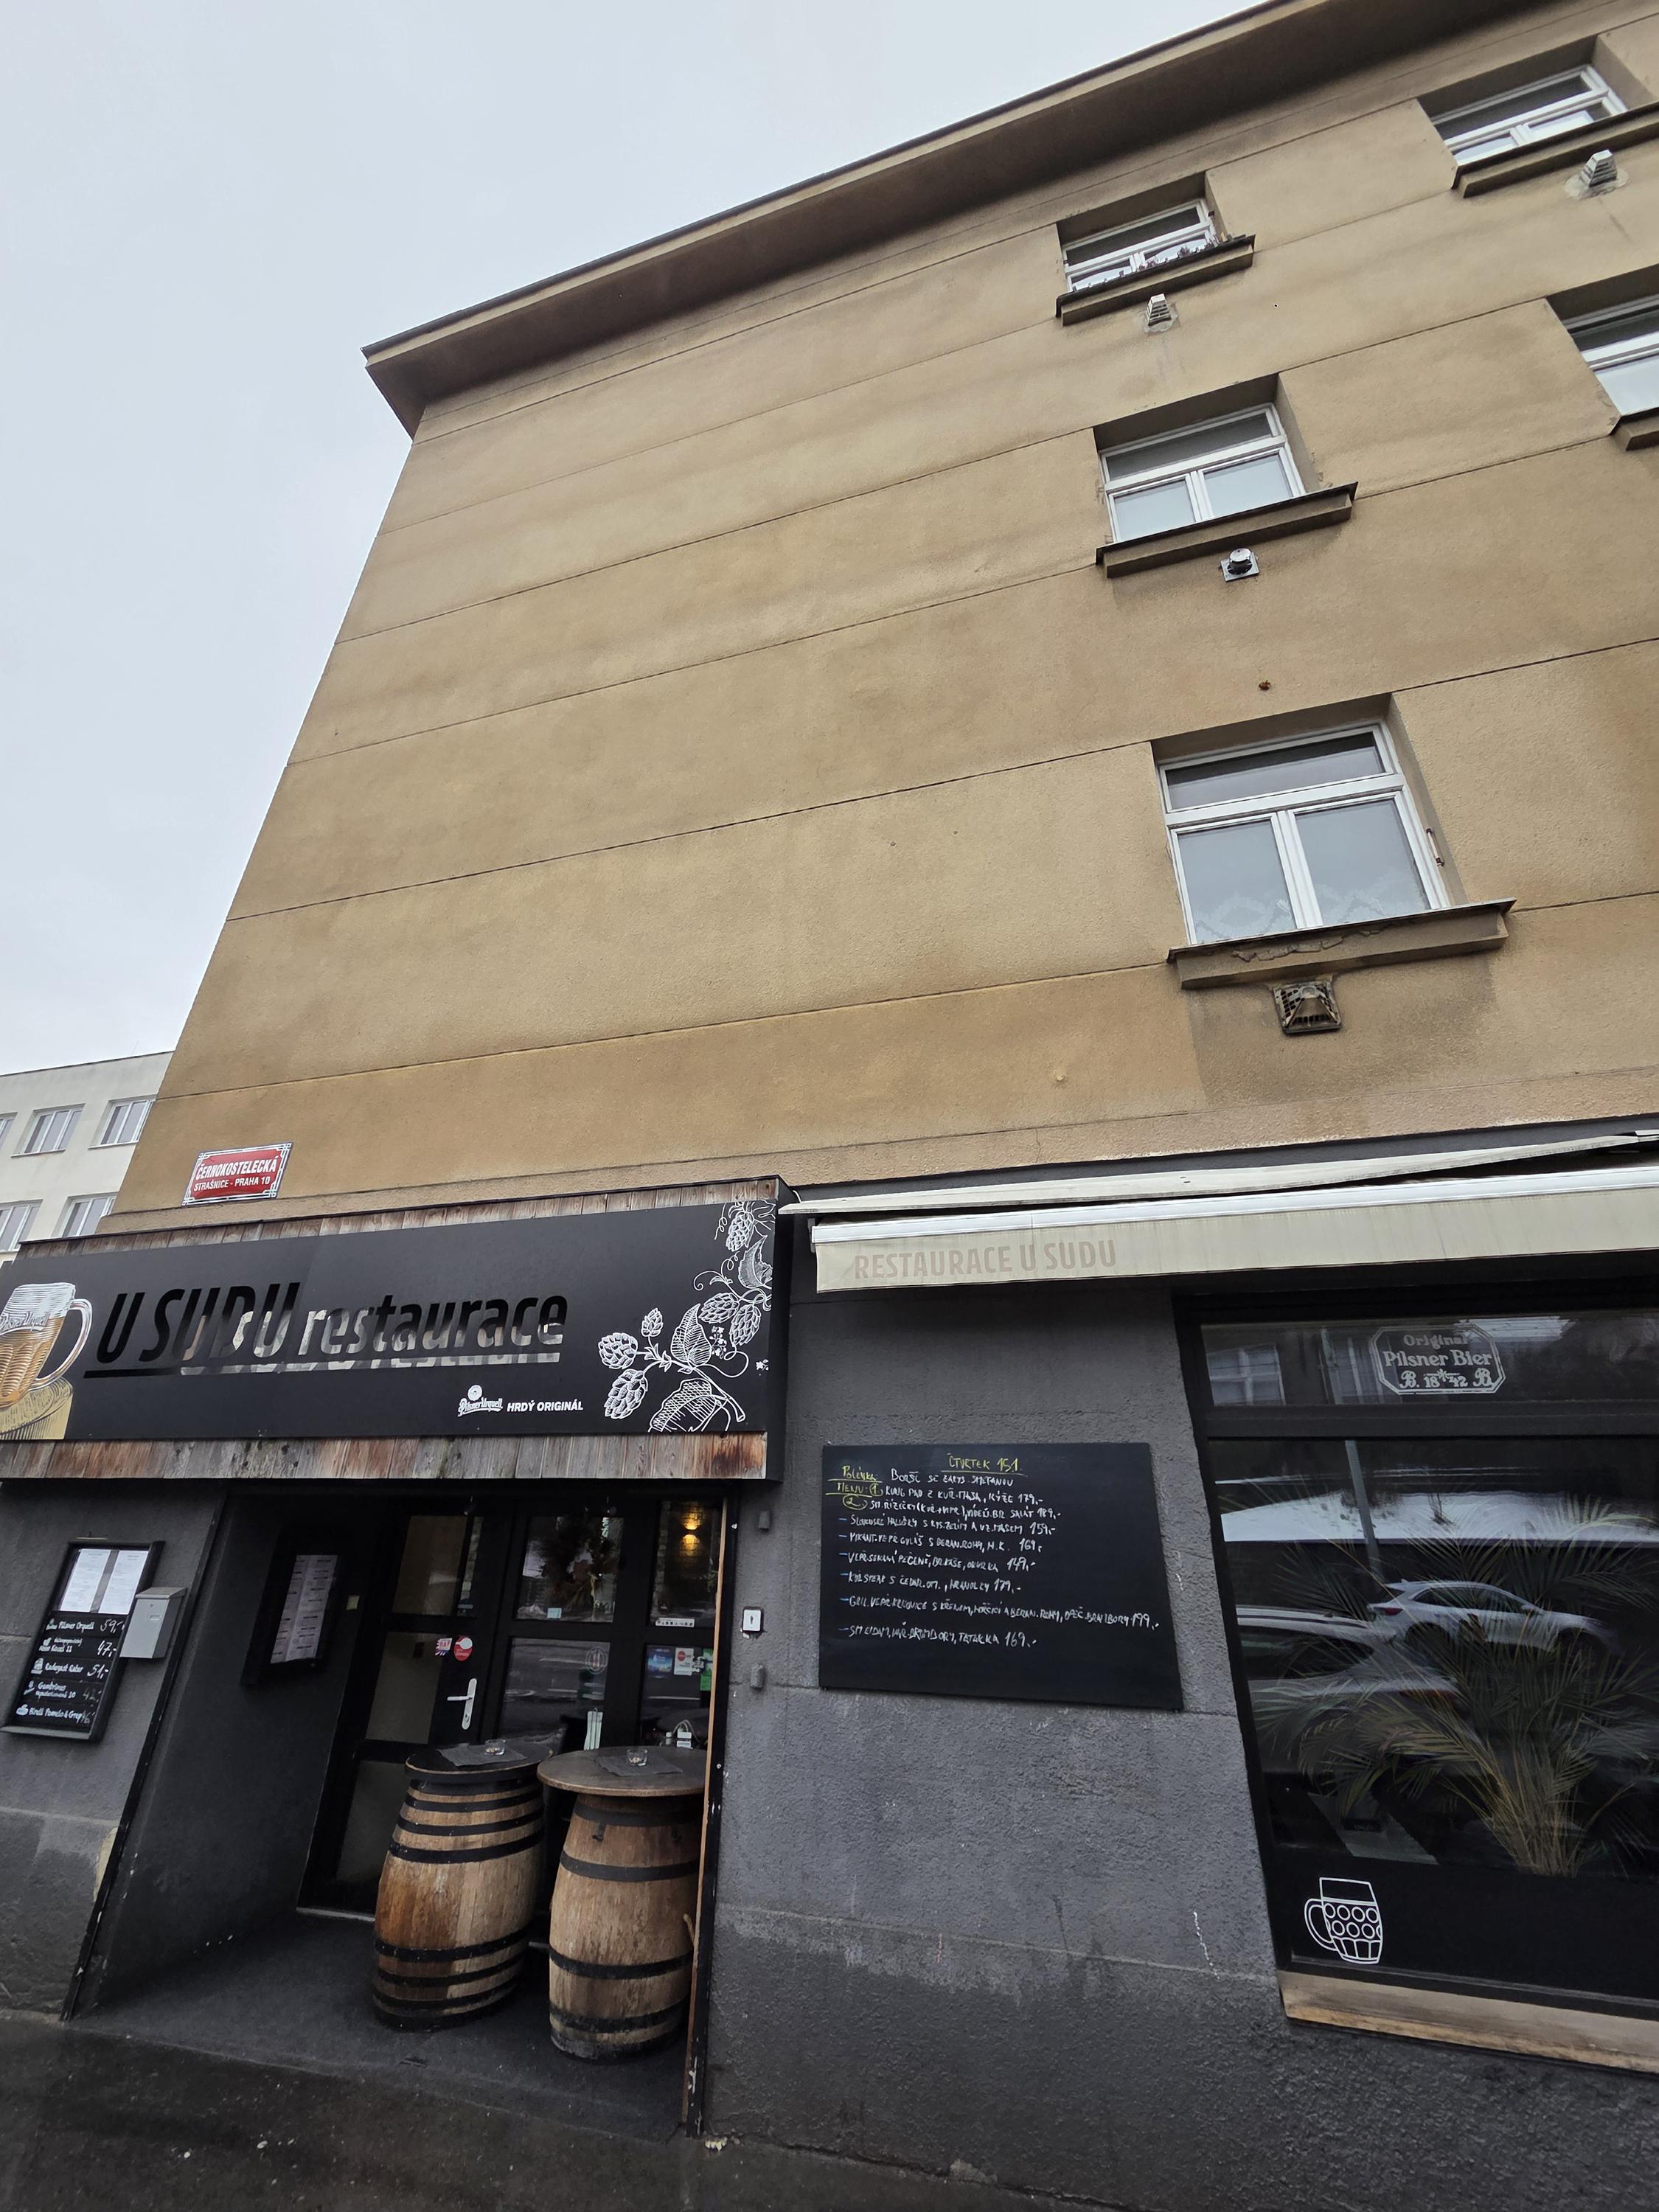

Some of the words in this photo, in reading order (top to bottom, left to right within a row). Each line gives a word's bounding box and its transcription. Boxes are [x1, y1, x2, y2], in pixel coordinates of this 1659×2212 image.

[195, 1155, 279, 1180] ČERNOKOSTELECKÁ
[193, 1179, 229, 1192] STRAŠNICE
[234, 1177, 259, 1187] PRAHA
[261, 1176, 271, 1185] 10
[855, 1245, 1013, 1280] RESTAURACE
[1019, 1244, 1036, 1272] U
[1044, 1239, 1117, 1270] SUDU
[97, 1292, 146, 1364] U
[139, 1282, 301, 1363] SUDU
[297, 1294, 568, 1357] restaurace
[1403, 1334, 1470, 1349] Original
[1382, 1350, 1450, 1367] Pilsner
[1450, 1349, 1493, 1366] Bier
[507, 1399, 535, 1412] HRDÝ
[536, 1399, 584, 1411] ORIGINÁL
[947, 1453, 990, 1470] ČTVRTEK
[886, 1485, 905, 1498] KUNG
[923, 1519, 928, 1528] S
[971, 1521, 978, 1532] A
[928, 1537, 934, 1547] S
[889, 1576, 897, 1585] S
[932, 1601, 938, 1611] S
